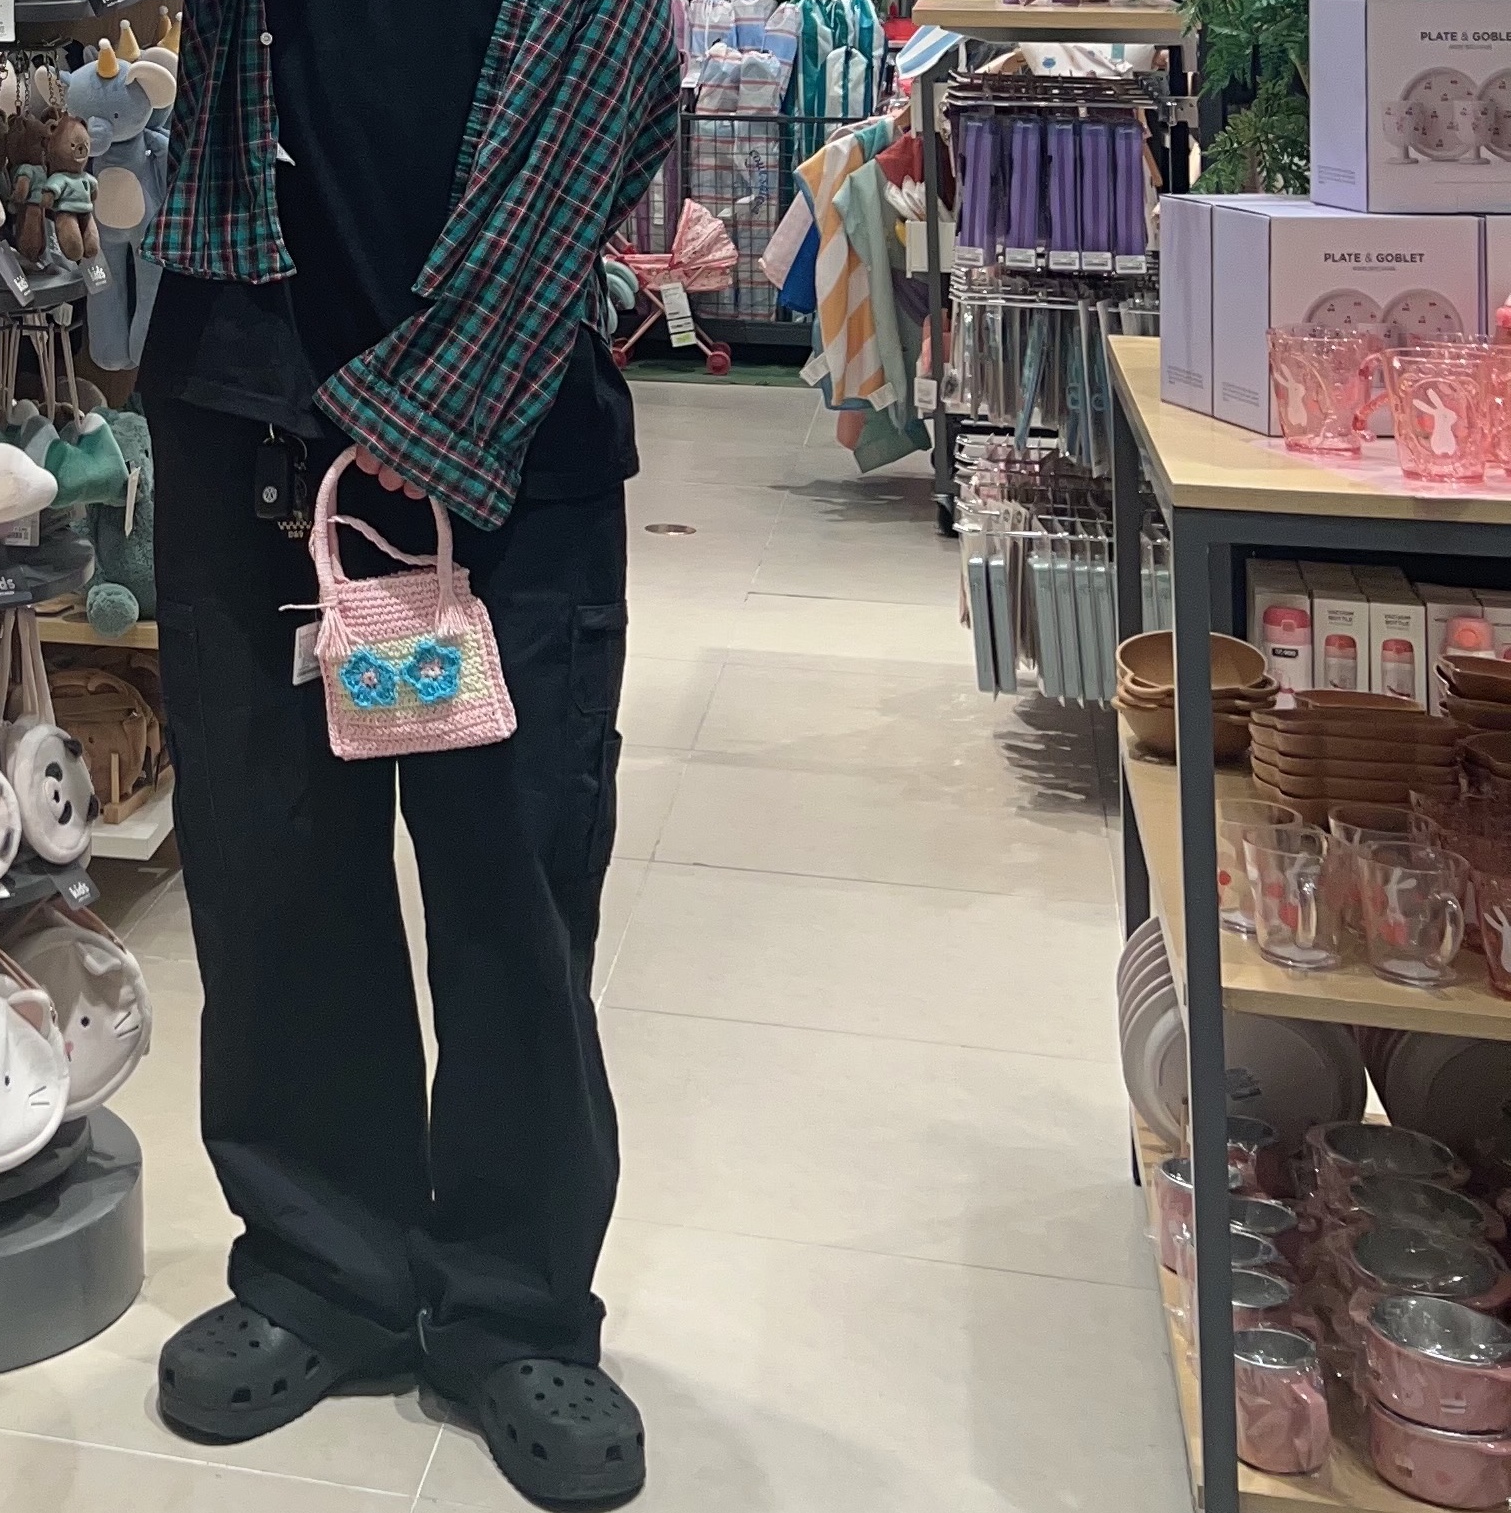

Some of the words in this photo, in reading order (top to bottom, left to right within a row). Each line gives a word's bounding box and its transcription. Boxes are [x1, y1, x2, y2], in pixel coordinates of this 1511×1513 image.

[1420, 31, 1457, 42] PLATE
[1461, 32, 1469, 42] &
[1472, 32, 1511, 42] GOBLE
[1323, 253, 1361, 263] PLATE
[1365, 253, 1373, 263] &
[1376, 253, 1425, 263] GOBLET
[68, 881, 90, 899] kids
